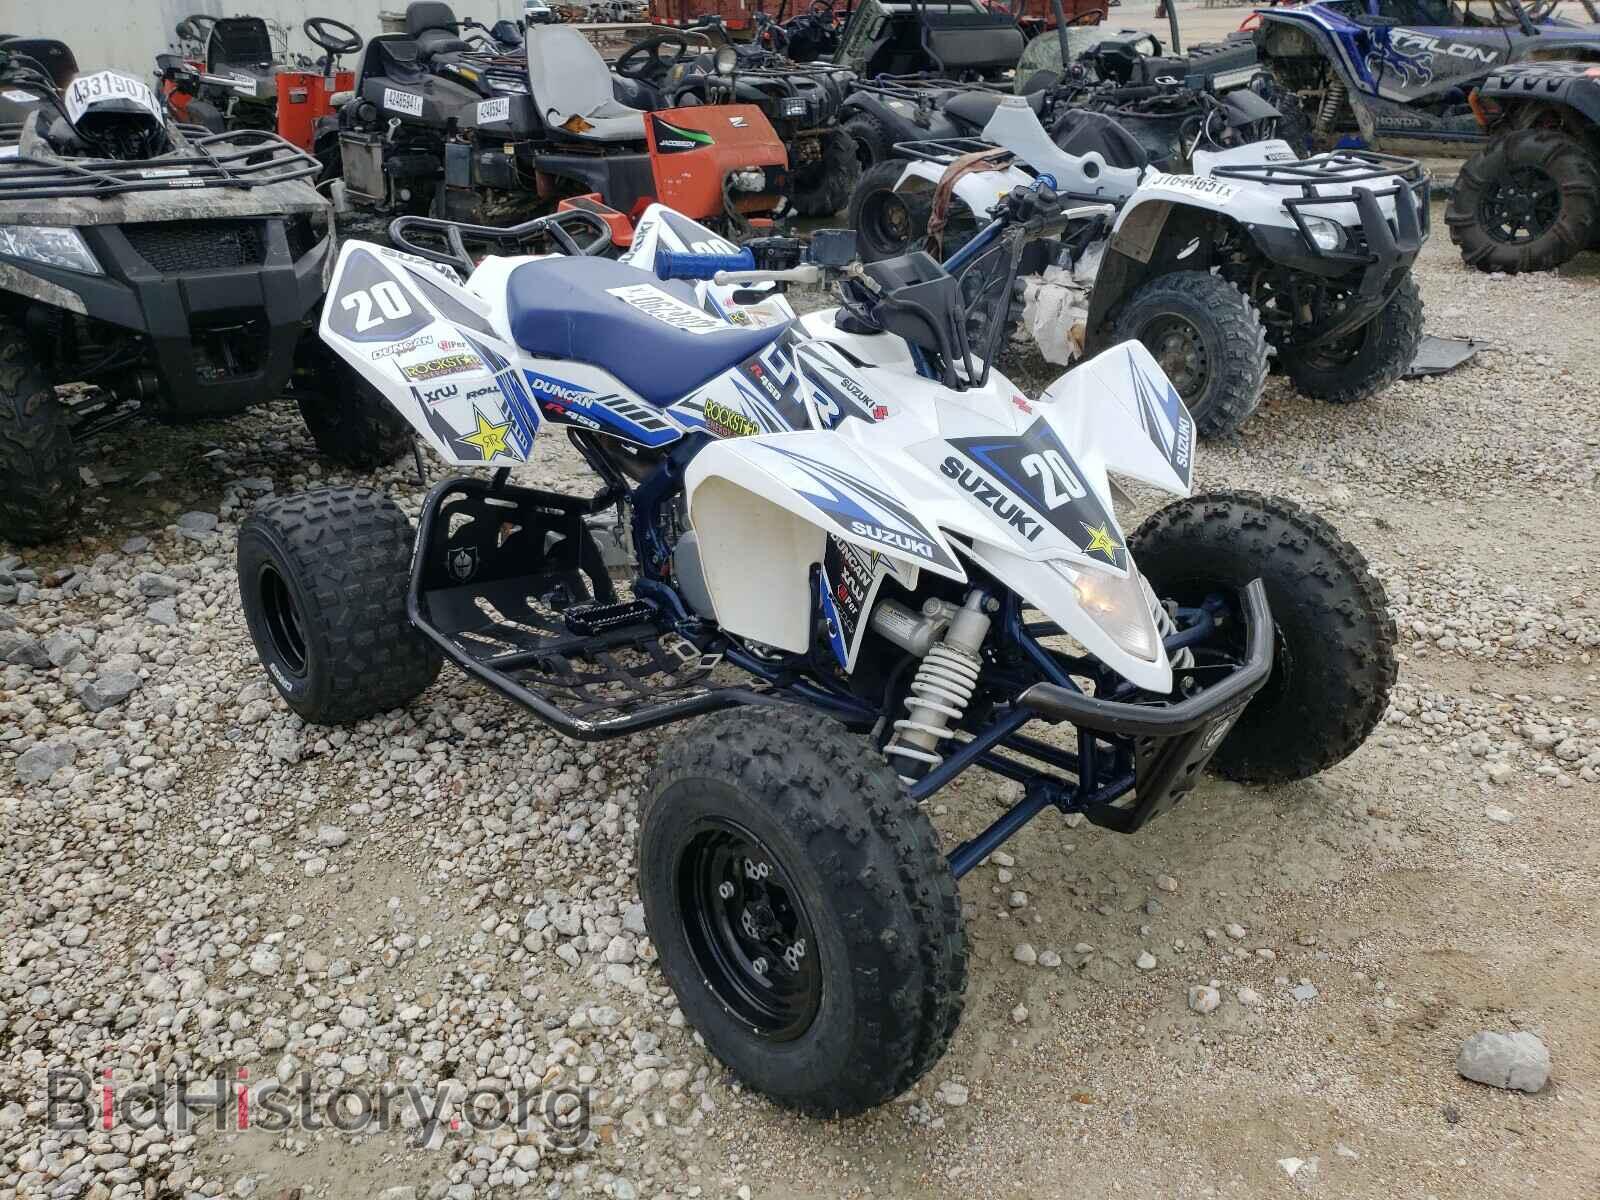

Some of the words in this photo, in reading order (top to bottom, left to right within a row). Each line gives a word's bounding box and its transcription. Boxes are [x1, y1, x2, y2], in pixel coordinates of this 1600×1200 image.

[1391, 27, 1498, 63] TALON
[1376, 115, 1423, 127] HONDA
[341, 280, 413, 333] 20
[372, 335, 434, 360] DUNCAN
[531, 378, 594, 409] DUNCAN
[841, 376, 877, 409] SUZUKI
[1176, 416, 1190, 468] SUZUKI
[1021, 449, 1088, 511] 20
[939, 456, 1045, 543] SUZUKI
[851, 521, 934, 559] SUZUKI
[830, 533, 872, 587] DUNCAN
